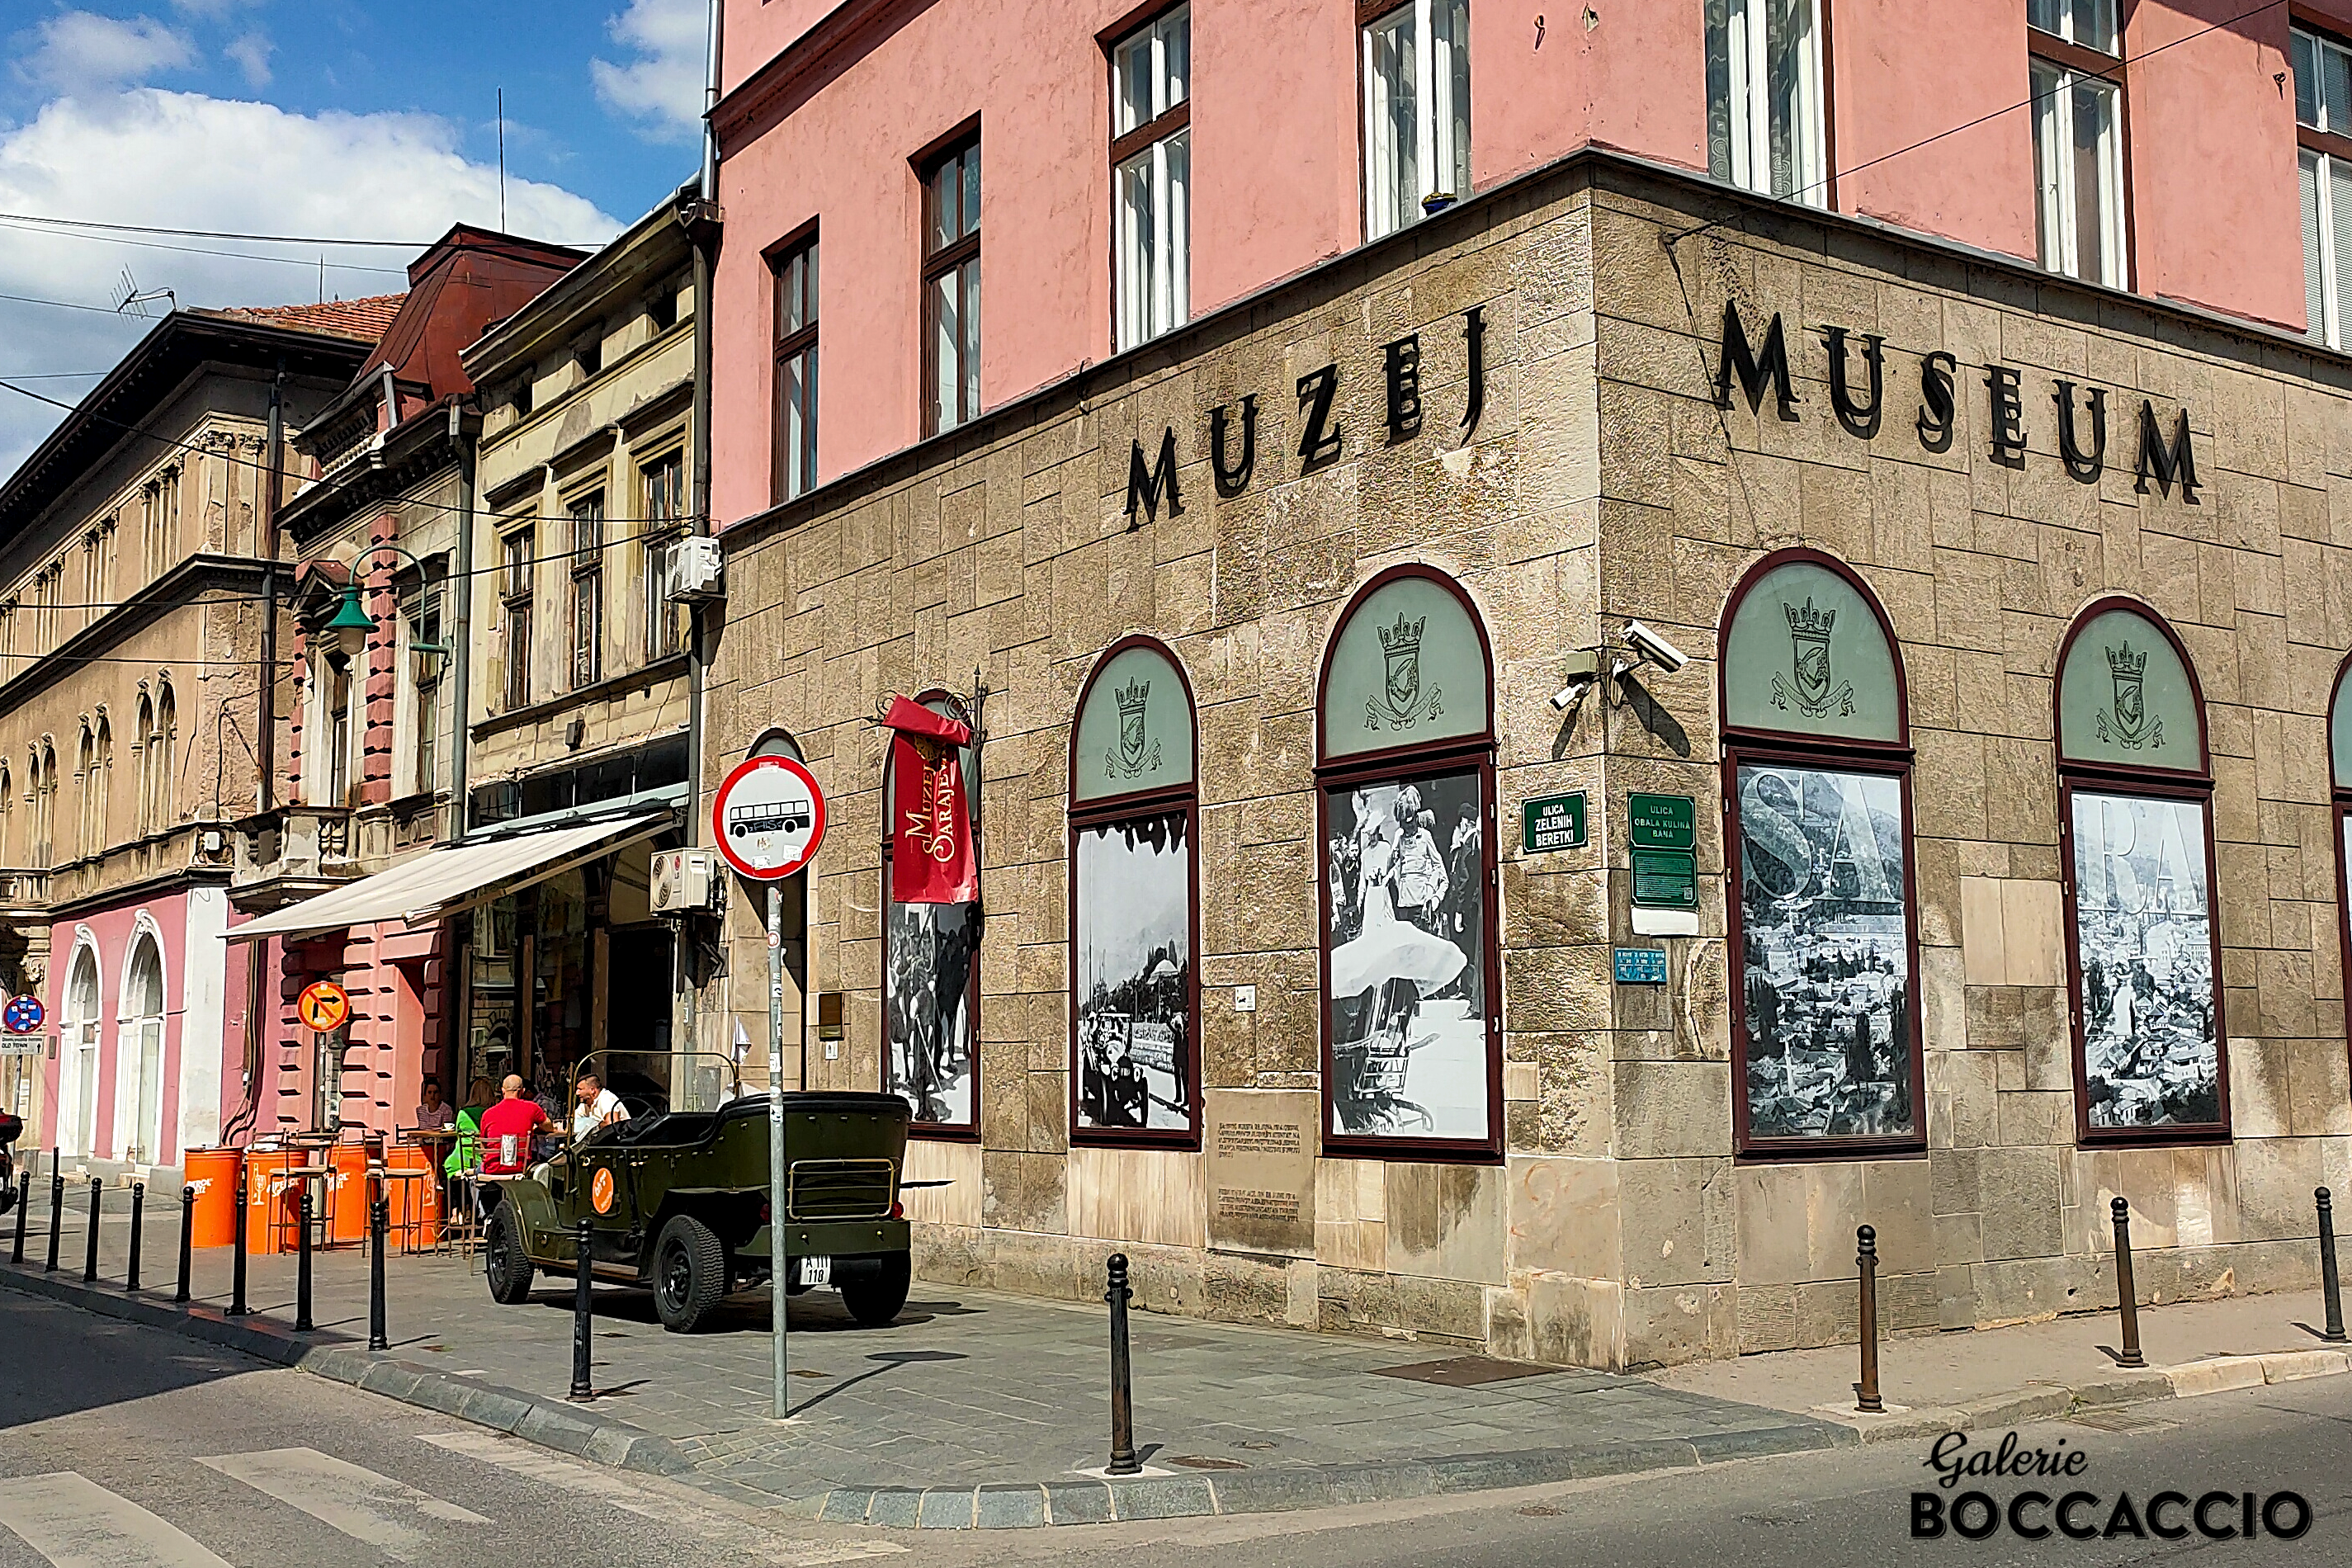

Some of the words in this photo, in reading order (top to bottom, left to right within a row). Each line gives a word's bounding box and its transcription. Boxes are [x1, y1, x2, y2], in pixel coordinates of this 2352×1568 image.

[1712, 298, 2203, 502] MUSEUM
[1123, 305, 1485, 523] MUZEJ
[1542, 804, 1564, 816] ULICA
[1650, 805, 1674, 815] ULICA
[1535, 814, 1572, 832] ZELENIH
[1635, 818, 1660, 827] OBALA
[1663, 819, 1691, 829] KULINA
[1536, 829, 1574, 847] BERETKI
[1653, 829, 1674, 838] BANA
